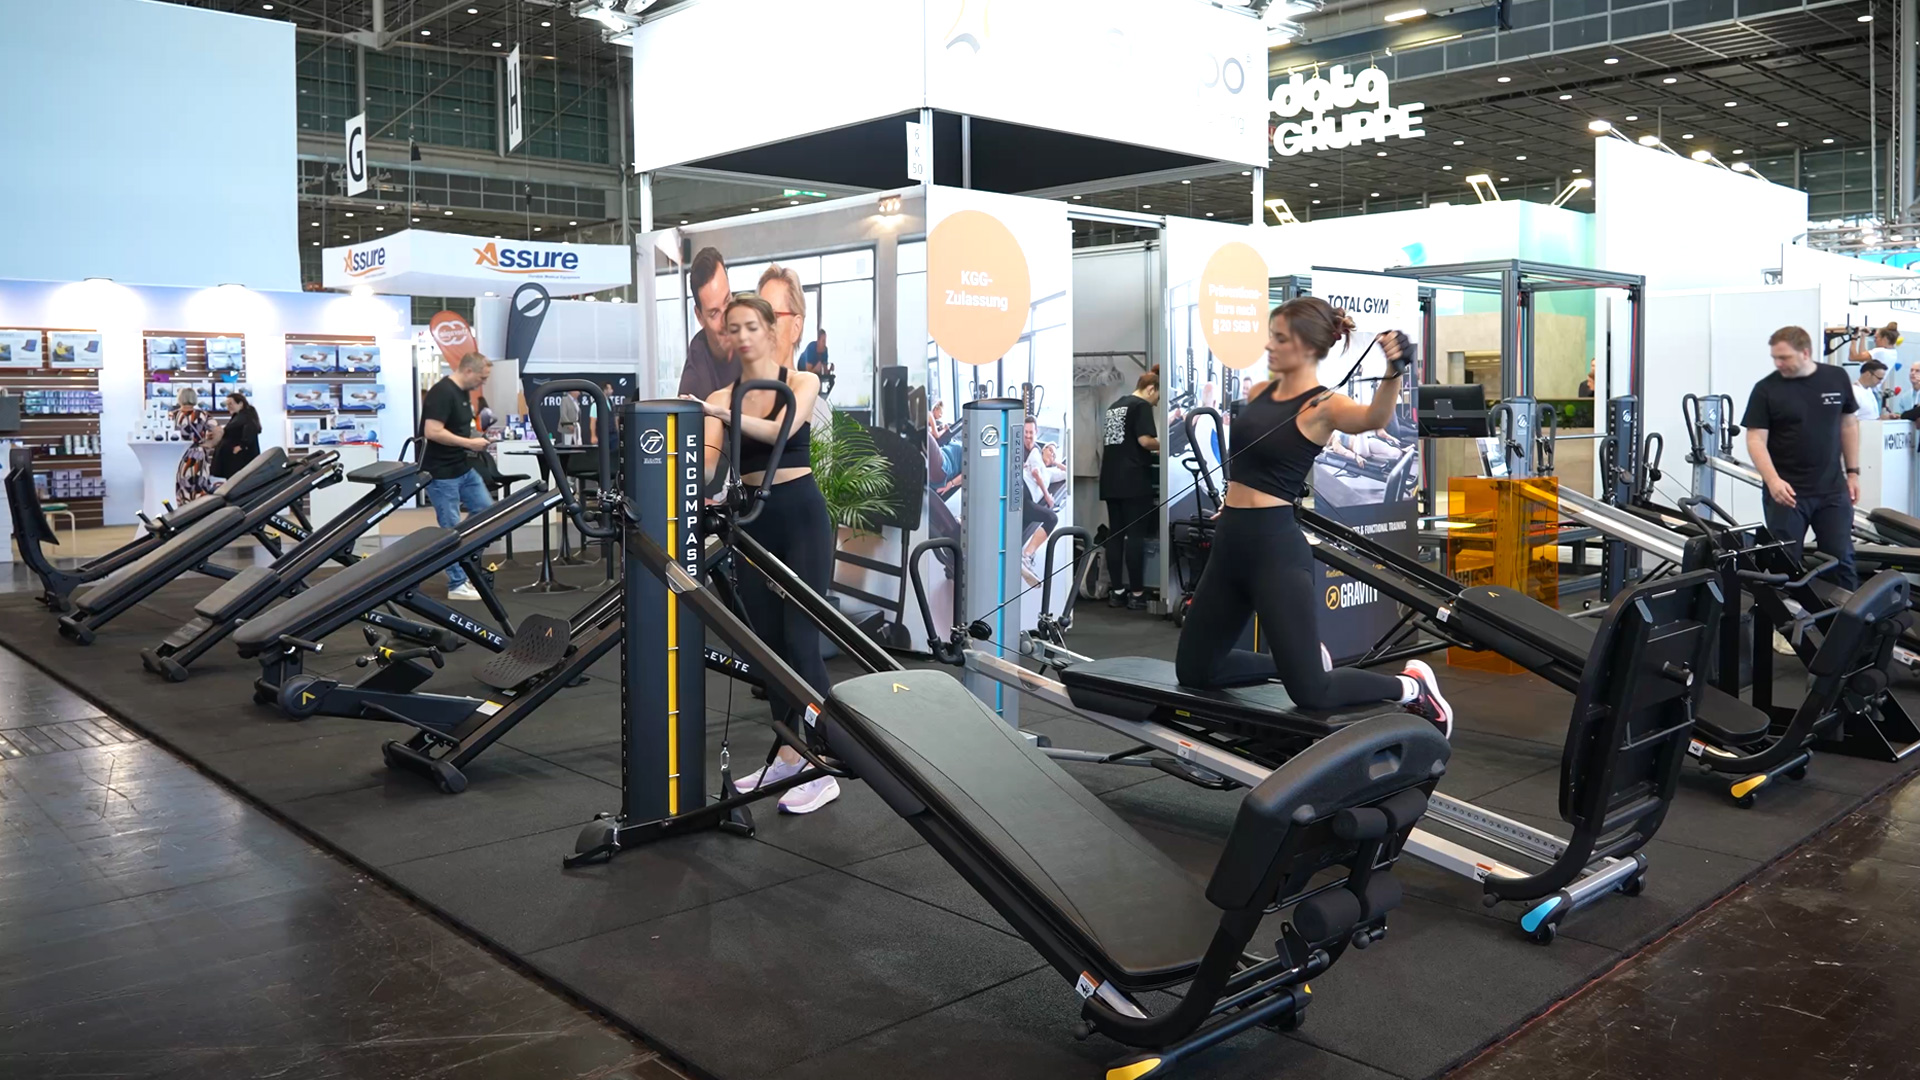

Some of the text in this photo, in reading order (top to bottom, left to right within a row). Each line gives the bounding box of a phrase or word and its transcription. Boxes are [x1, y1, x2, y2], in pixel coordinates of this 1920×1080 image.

[509, 63, 519, 135] H
[1272, 65, 1389, 117] data
[914, 128, 920, 140] 6
[1273, 103, 1425, 156] GRUPPE
[349, 126, 364, 182] G
[914, 146, 920, 157] K
[912, 163, 923, 174] 50
[473, 242, 579, 270] Assure
[961, 270, 993, 286] KGG-
[945, 289, 1008, 312] Zulassung
[1328, 294, 1389, 314] TOTAL GYM
[686, 434, 698, 577] ENCOMPASS
[270, 515, 308, 539] ELEVATE
[449, 613, 503, 646] ELEVATE
